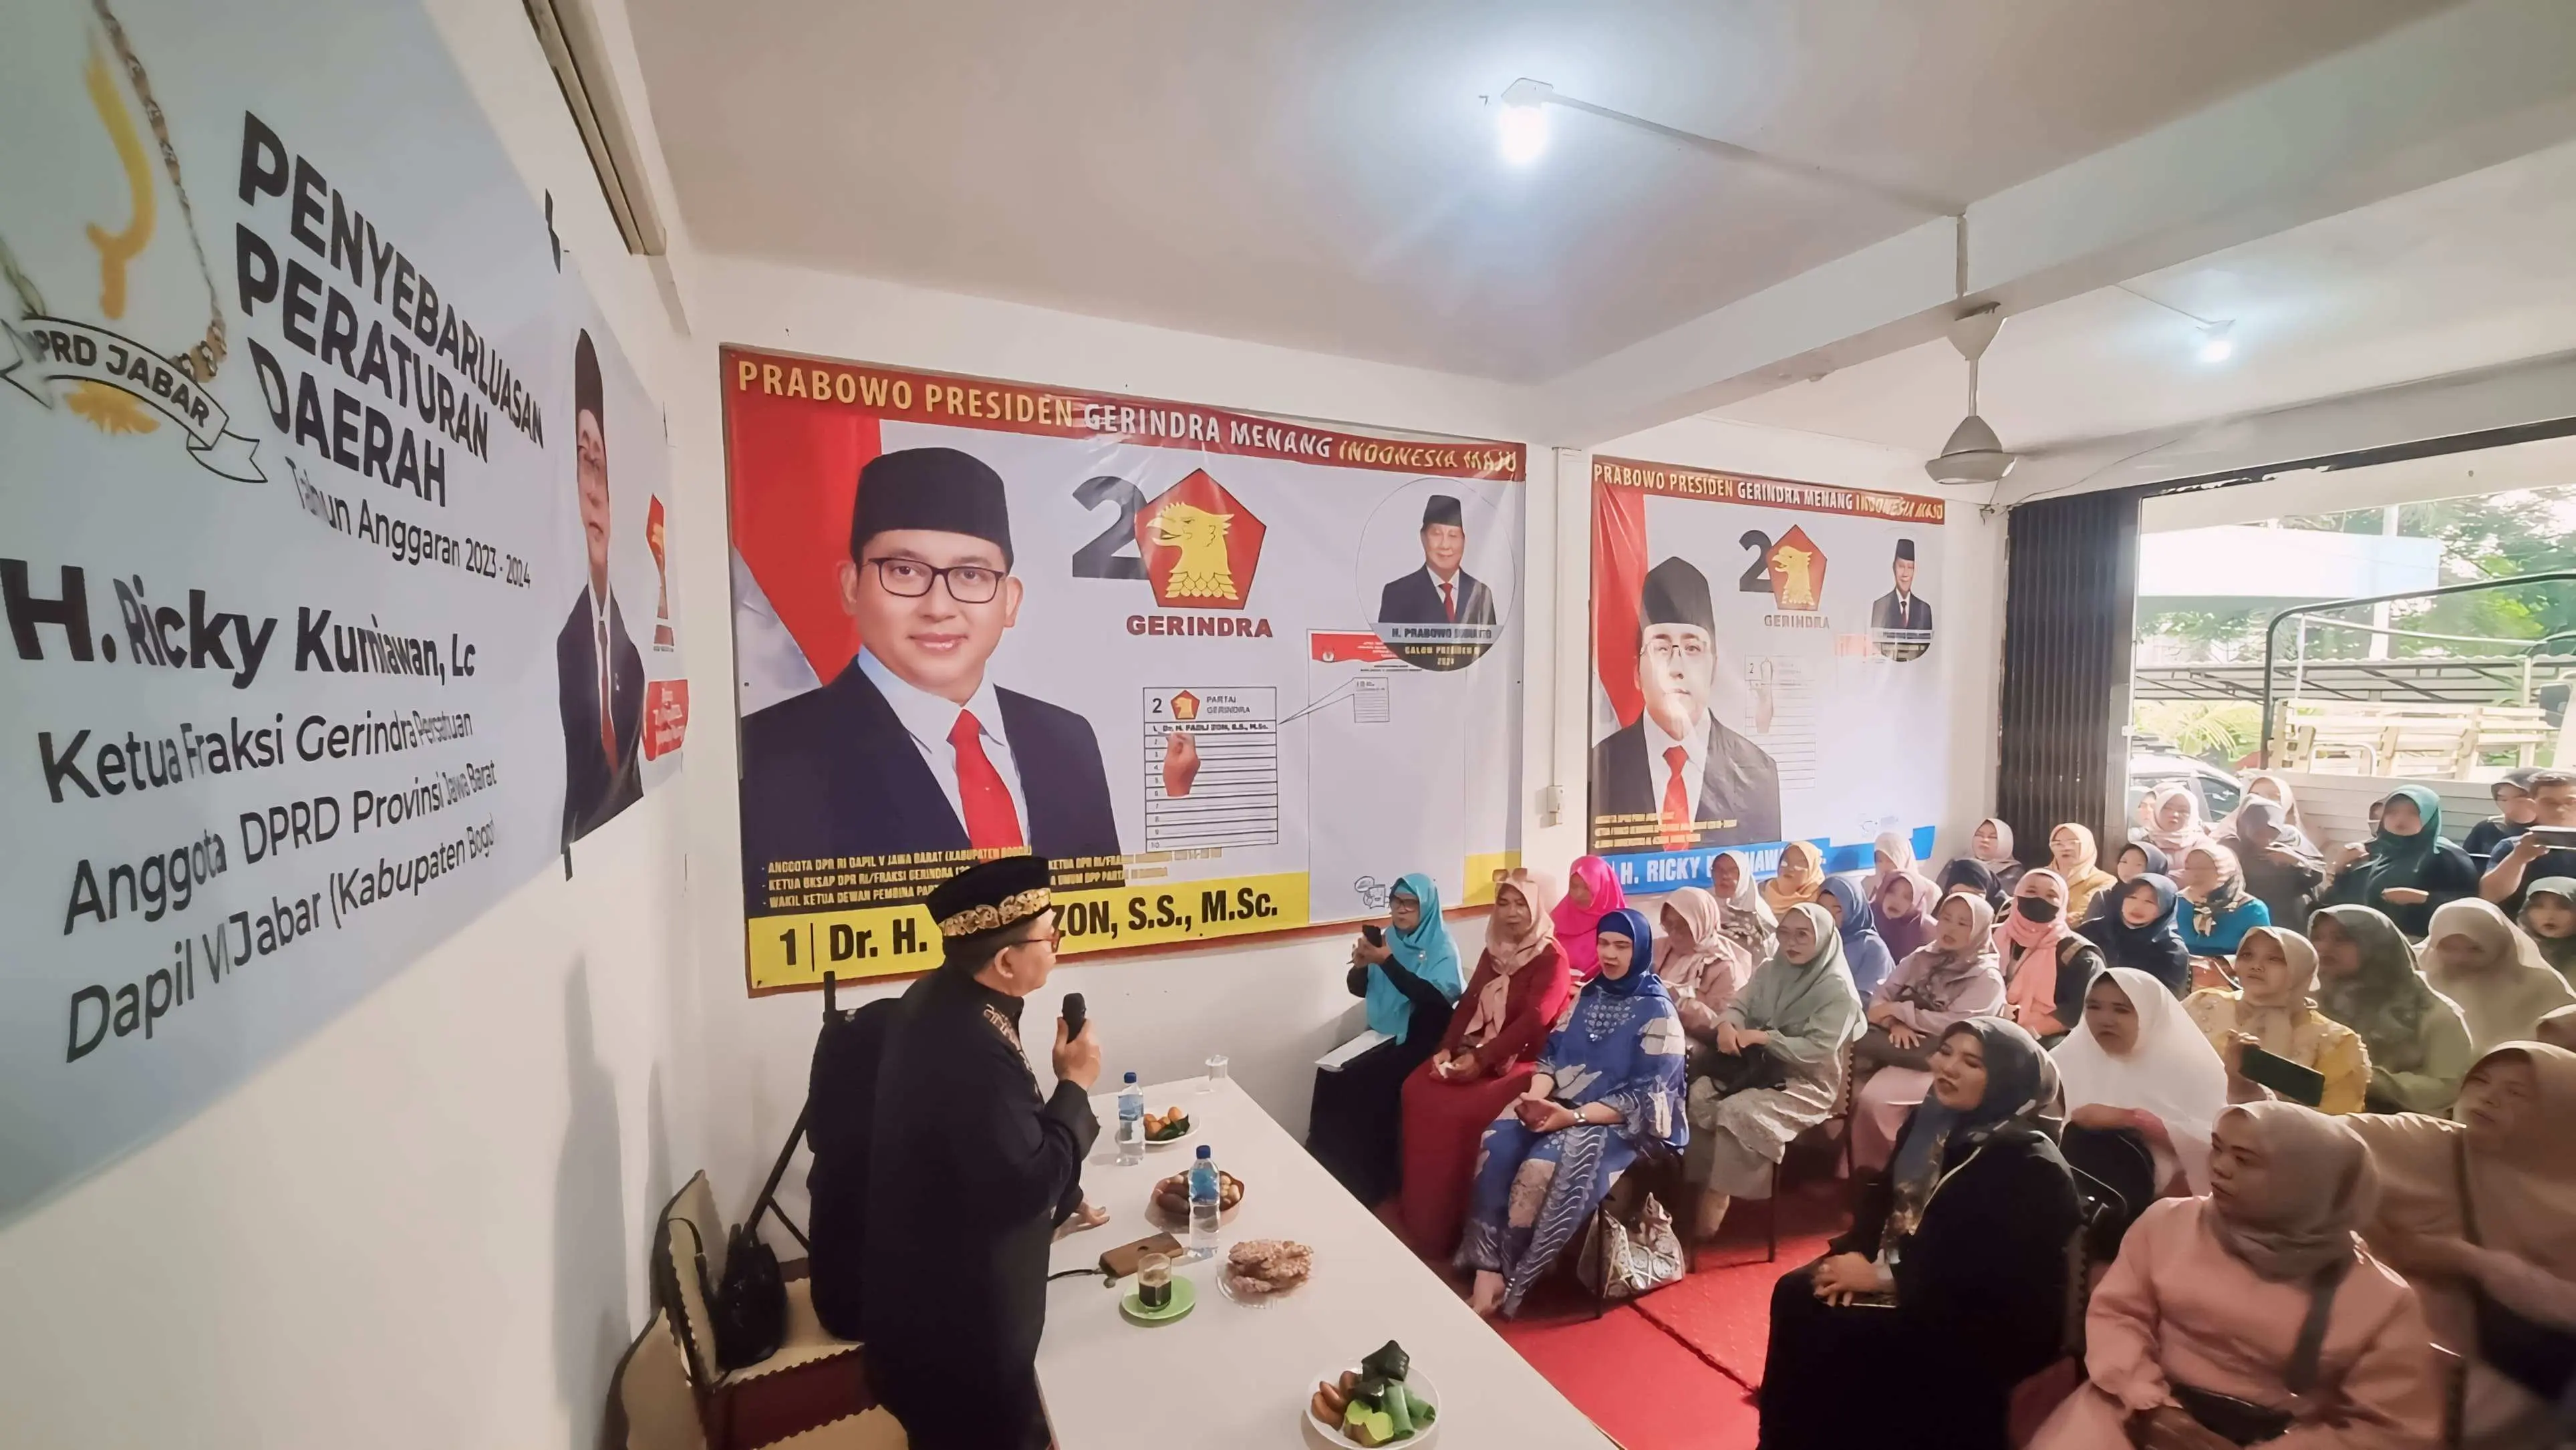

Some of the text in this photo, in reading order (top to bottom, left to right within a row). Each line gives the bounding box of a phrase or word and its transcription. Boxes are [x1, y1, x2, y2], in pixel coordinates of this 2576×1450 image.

[238, 110, 545, 449] PENYEBARLUASAN
[236, 223, 488, 463] PERATURAN
[106, 343, 210, 428] JABAR
[247, 337, 446, 507] DAERAH
[738, 360, 1517, 472] PRABOWO PRESIDEN GERINDRA MENANG INDONESIA MAJU
[1594, 463, 1665, 490] PRABOWO
[1669, 473, 1733, 497] PRESIDEN
[1737, 482, 1800, 504] GERINDRA
[1804, 490, 1853, 510] MENANG
[358, 498, 460, 565] Anggaran
[465, 537, 496, 579] 2023
[1071, 475, 1150, 580] 2
[1738, 529, 1774, 593] 2
[0, 558, 117, 663] H.
[112, 574, 278, 689] Ricky
[452, 633, 476, 676] Lc
[1126, 614, 1273, 639] GERINDRA
[1404, 628, 1452, 638] PRABOWO
[1764, 615, 1830, 629] GERINDRA
[1152, 698, 1163, 713] 2
[38, 729, 183, 803] Ketua
[180, 712, 284, 778] Fraksi
[296, 710, 418, 762] Gerindra
[63, 829, 227, 935] Anggota
[239, 796, 340, 865] DPRD
[353, 771, 444, 833] Provinsi
[466, 760, 497, 793] Barat
[768, 878, 801, 891] KETUA
[879, 855, 885, 867] V
[1620, 861, 1638, 885] H.
[1647, 856, 1701, 883] RICKY
[769, 896, 801, 908] WAKIL
[803, 893, 835, 906] KETUA
[829, 923, 878, 962] Dr.
[893, 917, 927, 955] H.
[1128, 894, 1191, 932] S.S.,
[1201, 887, 1278, 923] M.Sc.
[66, 938, 194, 1063] Dapil
[229, 892, 321, 967] Jabar
[329, 839, 465, 929] (Kabupaten
